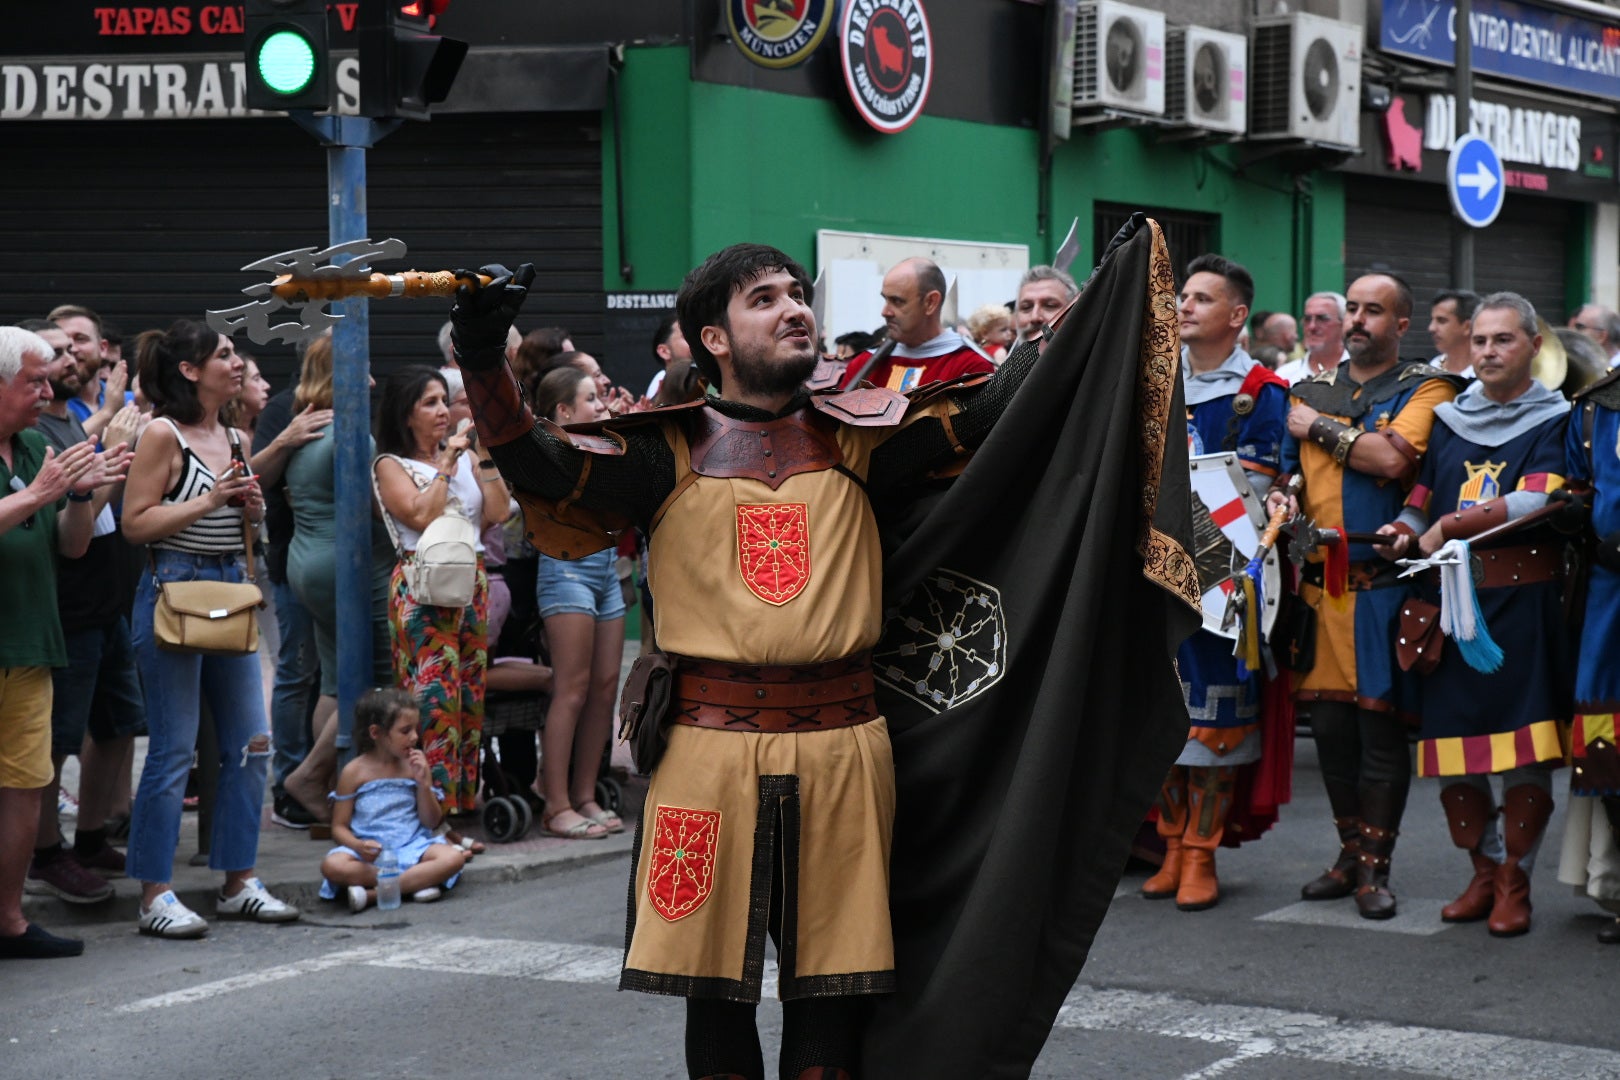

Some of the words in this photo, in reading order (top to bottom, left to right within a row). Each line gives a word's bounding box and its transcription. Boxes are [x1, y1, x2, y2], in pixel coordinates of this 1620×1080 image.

[94, 6, 192, 36] TAPAS
[1447, 6, 1509, 53] CNTRO
[1511, 22, 1565, 66] DENTAL
